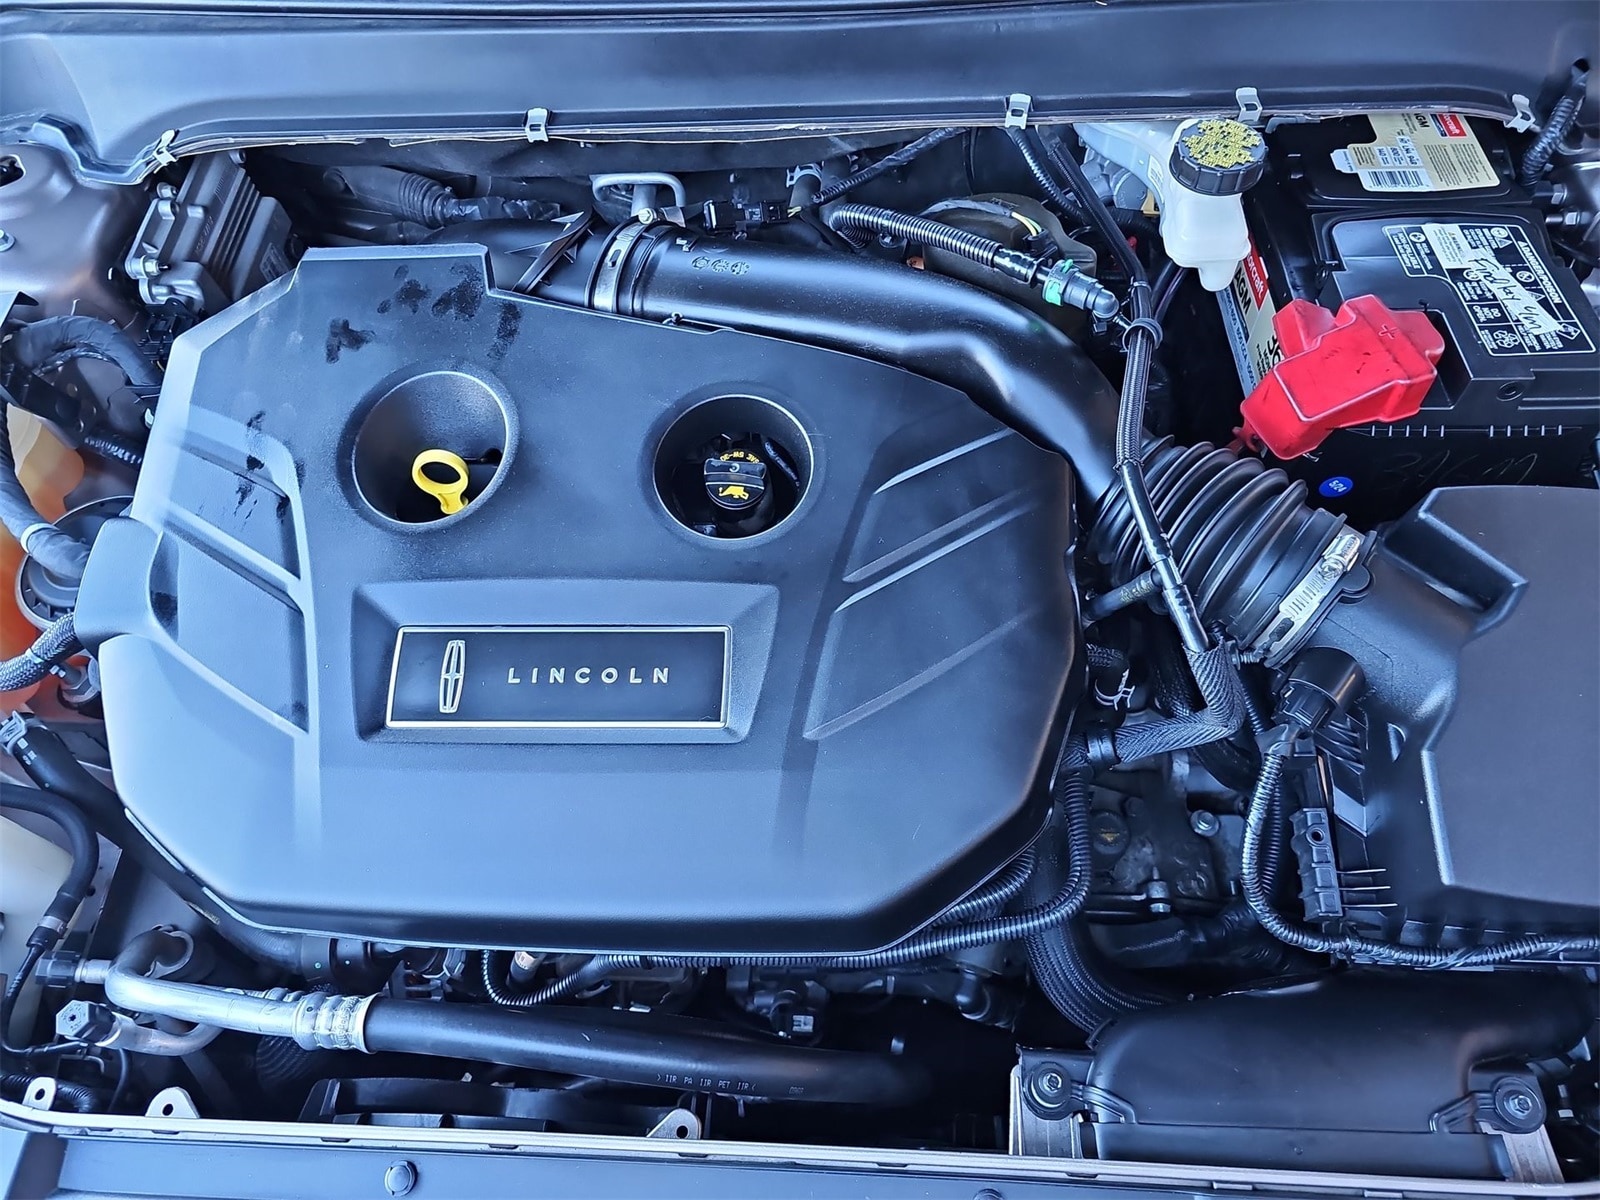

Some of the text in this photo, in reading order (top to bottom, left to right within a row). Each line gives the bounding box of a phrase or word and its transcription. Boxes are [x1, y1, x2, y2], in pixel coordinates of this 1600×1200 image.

[1234, 266, 1252, 315] AGM
[1482, 307, 1495, 320] NOT
[1490, 308, 1502, 318] DO
[746, 453, 760, 464] SAE
[507, 667, 669, 684] LINCOLN
